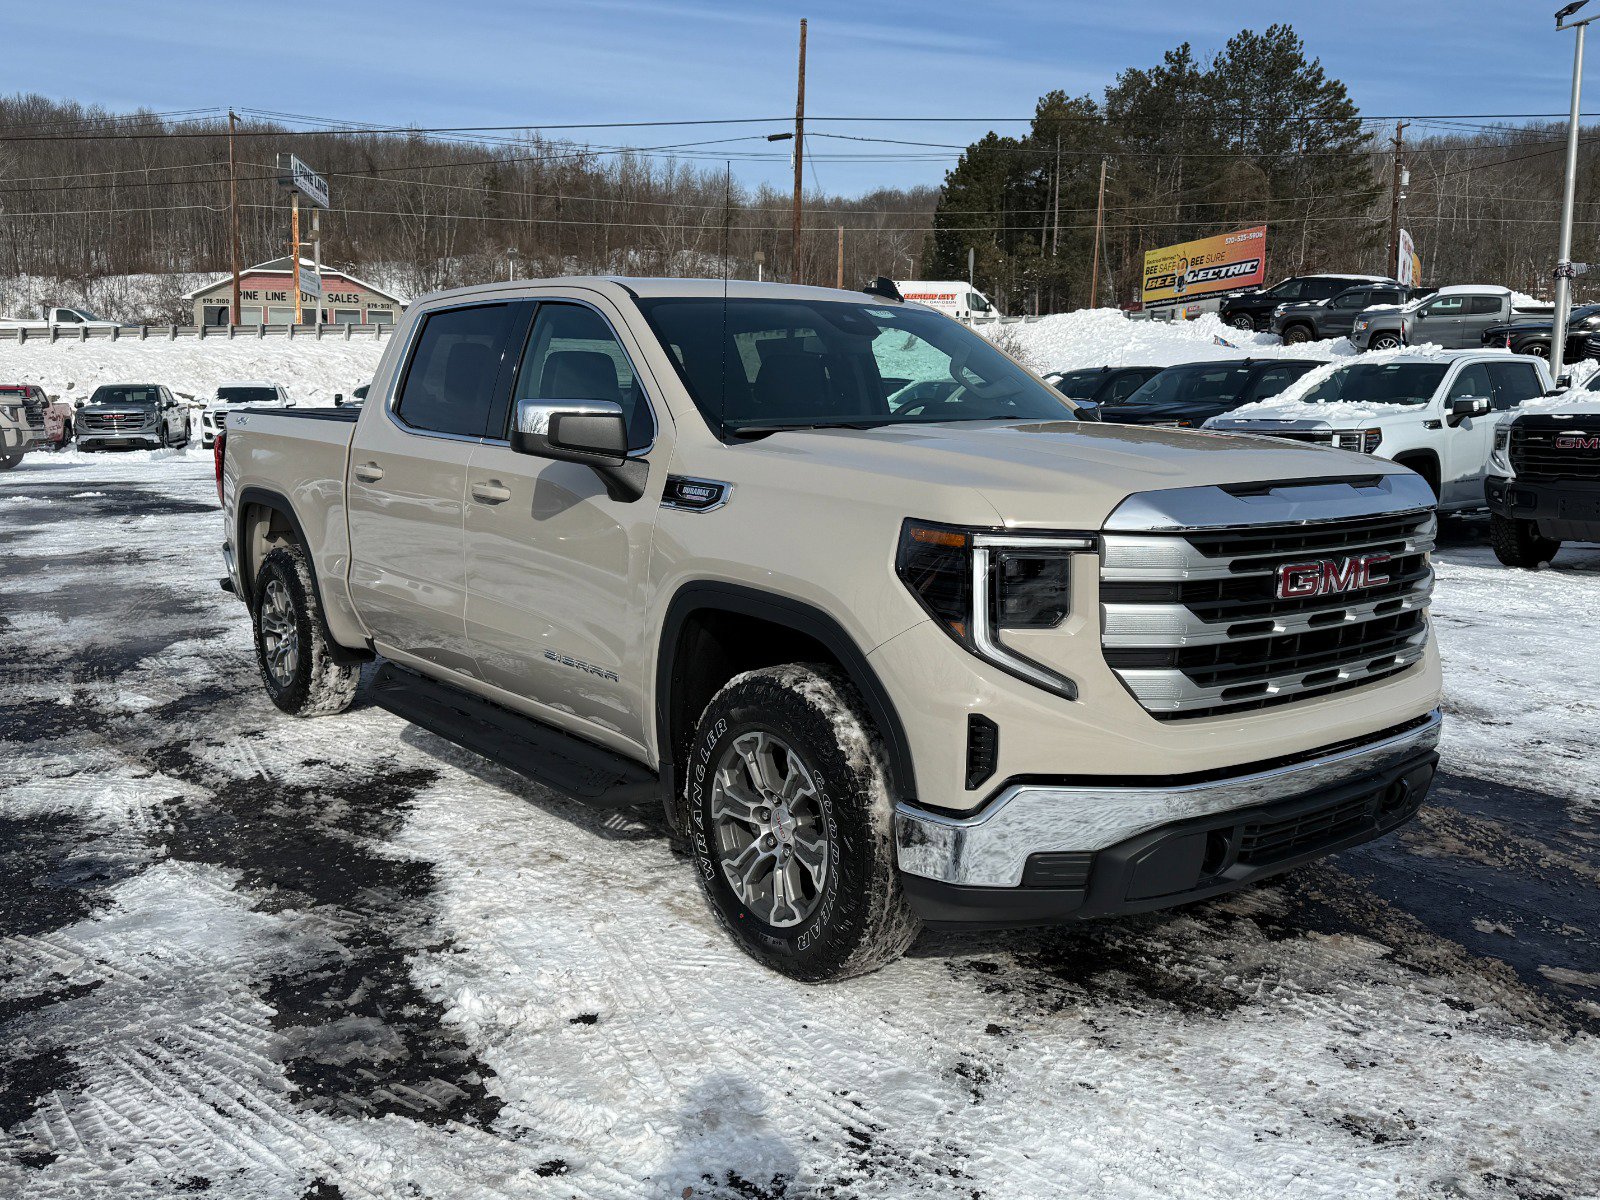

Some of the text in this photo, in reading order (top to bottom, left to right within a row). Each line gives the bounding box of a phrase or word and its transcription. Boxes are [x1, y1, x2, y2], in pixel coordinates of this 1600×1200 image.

[314, 175, 328, 198] LINE
[1145, 251, 1226, 276] BEE SAFE BEE SURE
[1146, 260, 1260, 289] BEE LECTRIC
[265, 291, 287, 302] LINE
[327, 293, 360, 304] SALES
[1556, 437, 1600, 449] GM
[682, 486, 711, 497] DURAMAX
[1276, 551, 1391, 599] GMC
[543, 648, 620, 683] SIERRA
[693, 717, 728, 881] WRANGLER
[775, 812, 786, 839] GMC
[797, 769, 841, 951] GOODYEAR
